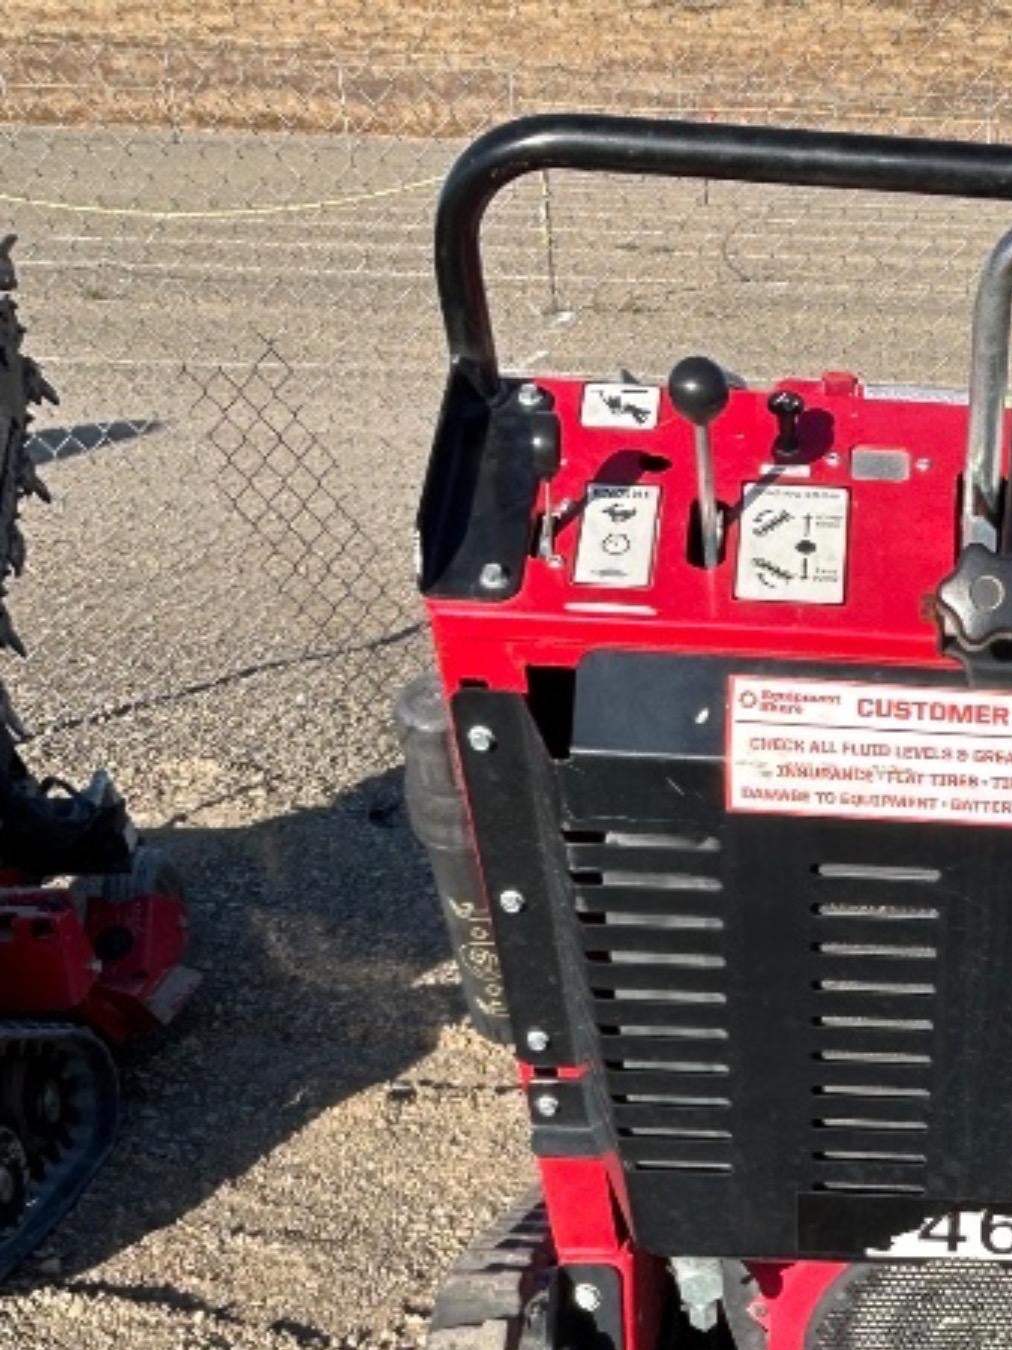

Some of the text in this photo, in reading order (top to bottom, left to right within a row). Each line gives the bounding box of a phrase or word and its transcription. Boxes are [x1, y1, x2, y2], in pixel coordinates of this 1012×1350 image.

[857, 697, 1009, 727] CUSTOMER
[749, 737, 805, 753] CHECK
[809, 740, 838, 755] ALL
[842, 742, 891, 758] FLUID
[895, 745, 953, 761] LEVELS
[930, 772, 979, 789] TIRES
[740, 786, 811, 802] DAMAGE
[815, 791, 837, 806] TO
[839, 792, 940, 811] EQUIPMENT
